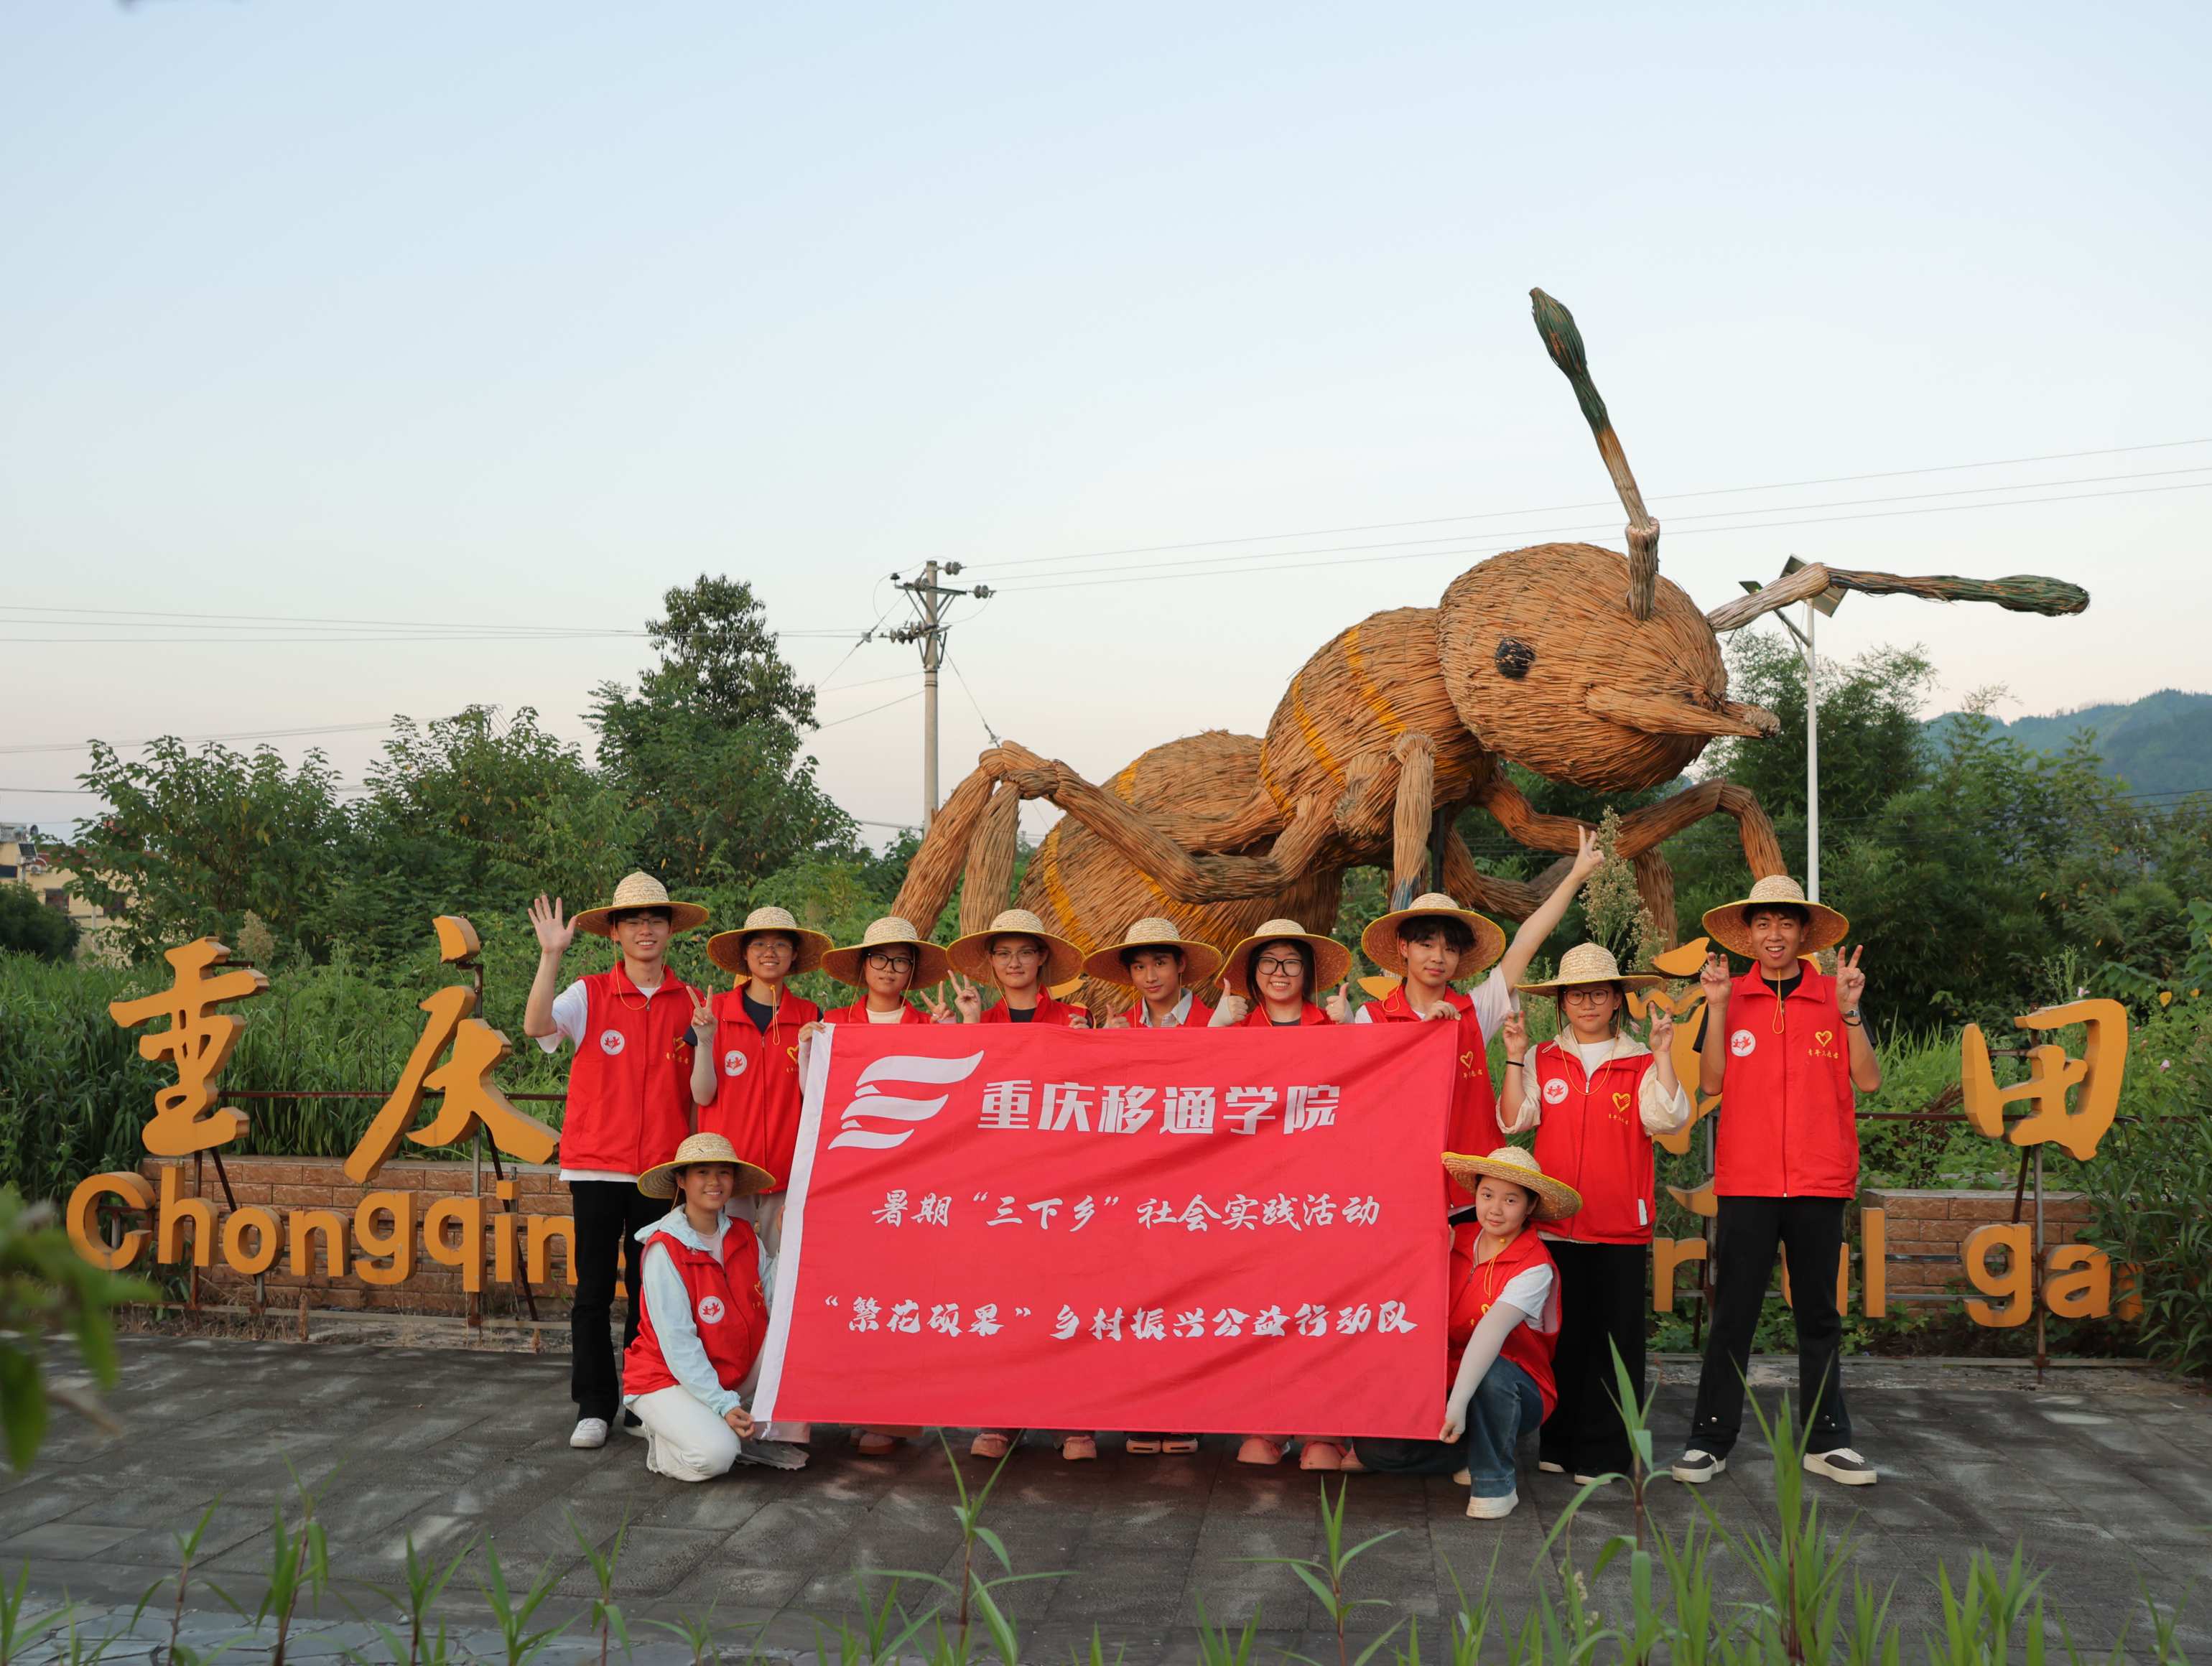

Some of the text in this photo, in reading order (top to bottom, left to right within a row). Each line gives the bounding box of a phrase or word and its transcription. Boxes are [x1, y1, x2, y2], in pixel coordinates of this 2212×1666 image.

[977, 1078, 1341, 1135] 重庆移通学院
[67, 1166, 629, 1298] Chongqin
